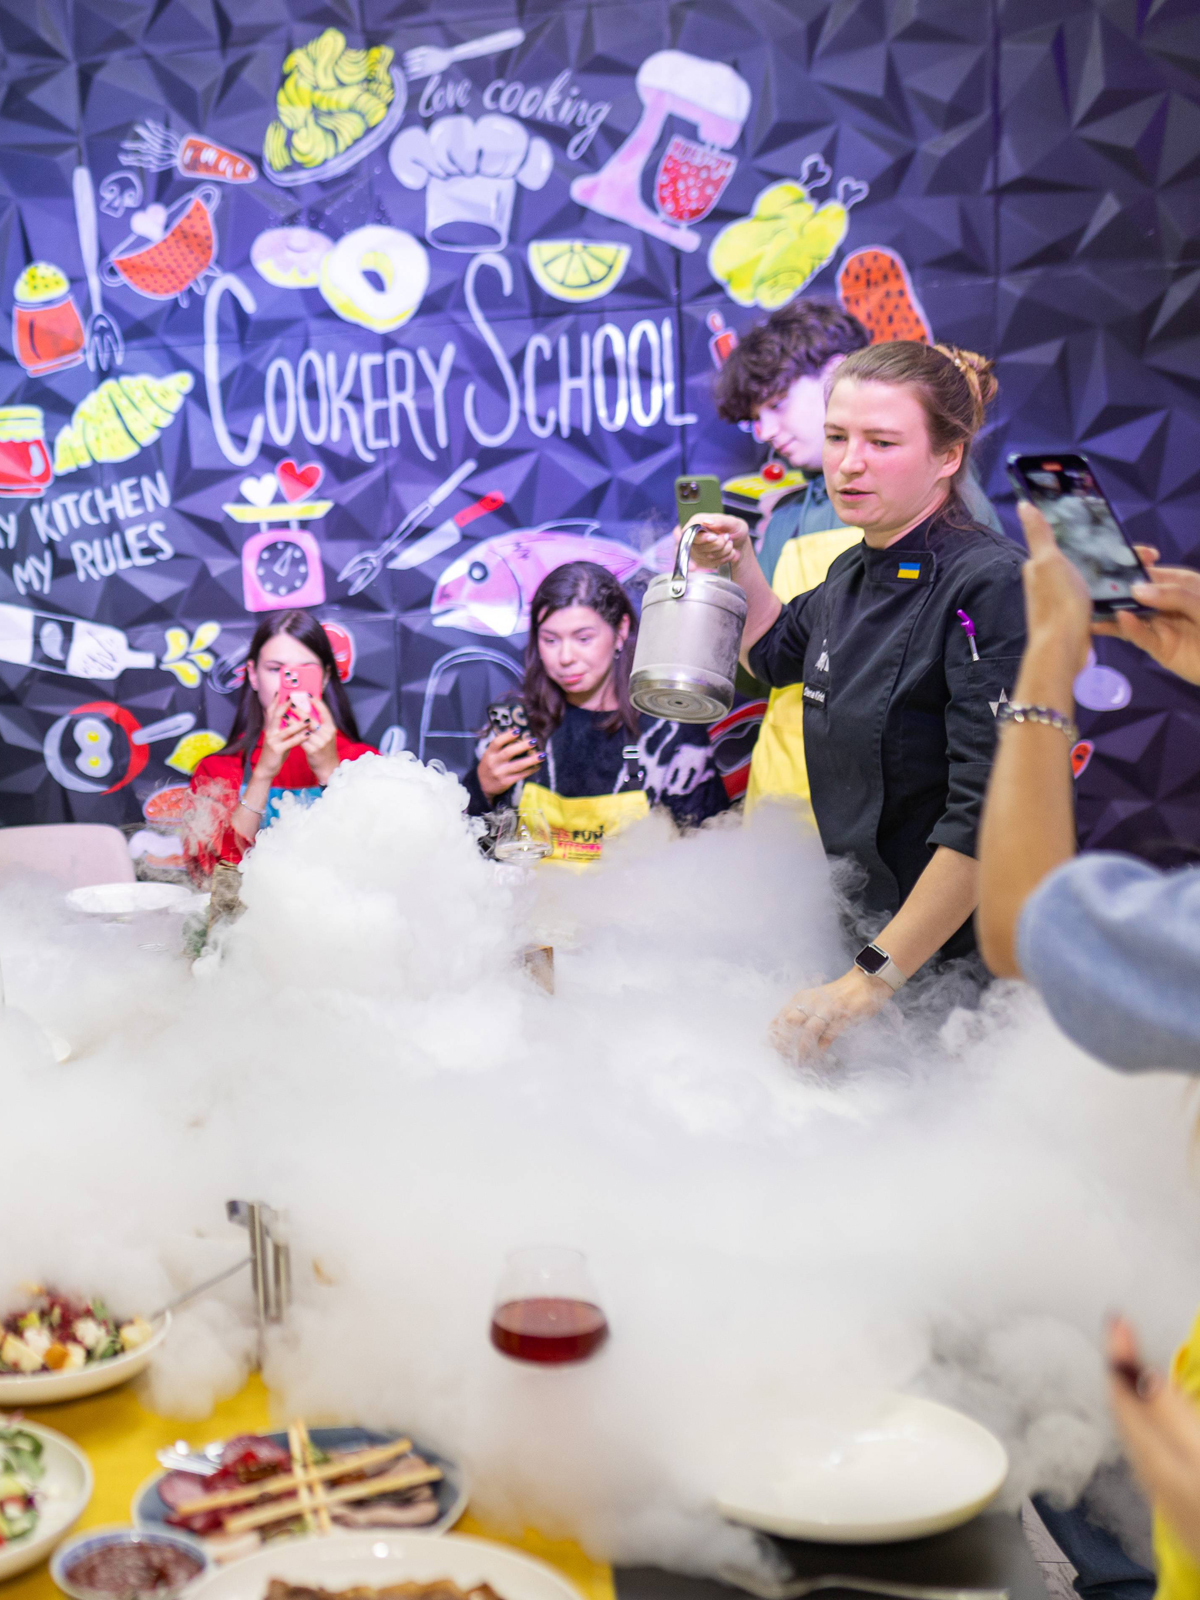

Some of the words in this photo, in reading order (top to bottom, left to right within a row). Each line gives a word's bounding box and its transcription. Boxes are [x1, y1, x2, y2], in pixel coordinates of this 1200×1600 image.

[418, 74, 472, 118] love
[482, 67, 613, 161] cooking
[203, 272, 457, 467] COOKERY
[463, 251, 698, 448] SCHOOL
[30, 469, 171, 544] KITCHEN
[12, 548, 53, 596] MY
[69, 520, 175, 583] RULES
